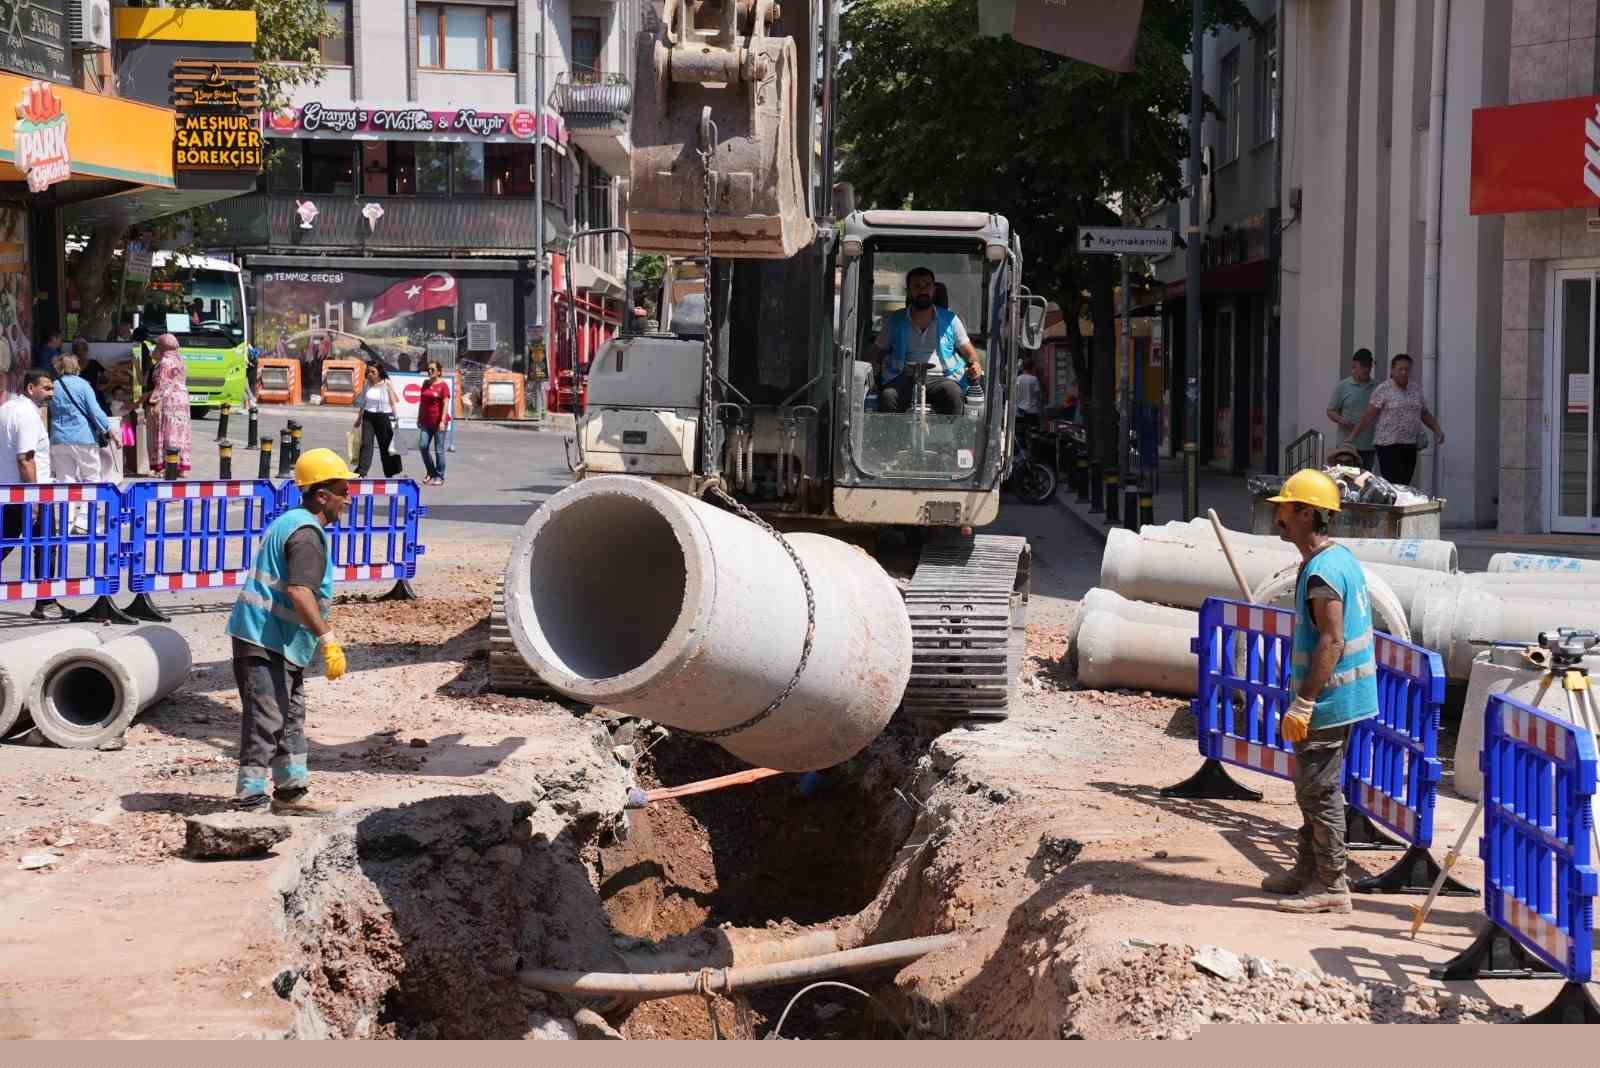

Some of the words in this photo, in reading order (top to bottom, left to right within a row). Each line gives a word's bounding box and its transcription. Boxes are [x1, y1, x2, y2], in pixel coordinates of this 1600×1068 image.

[186, 115, 249, 134] MEŞHUR
[304, 103, 367, 131] Granny's
[438, 117, 449, 130] &
[455, 110, 505, 135] Kumpir
[19, 121, 70, 174] PARK
[177, 130, 260, 148] SARIYER
[176, 147, 260, 168] BÖREKÇİSİ
[1099, 237, 1169, 248] Kaymakamlık
[274, 271, 310, 282] TEMMUZ
